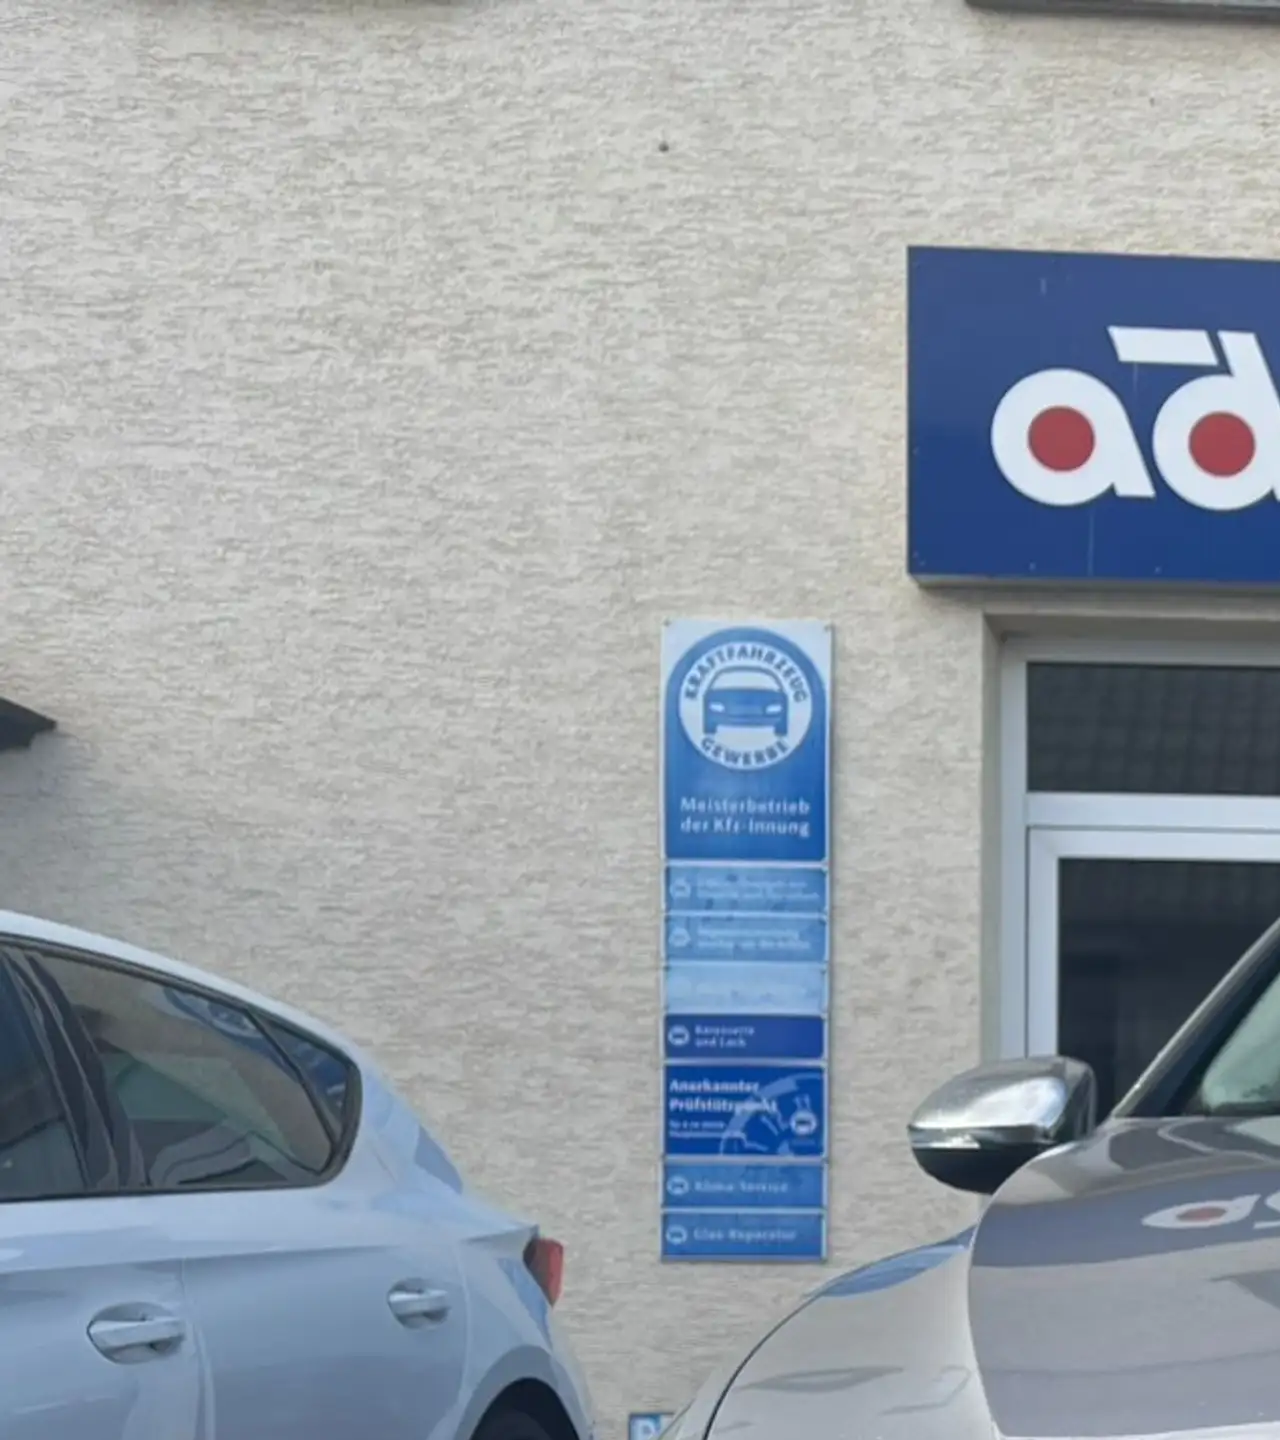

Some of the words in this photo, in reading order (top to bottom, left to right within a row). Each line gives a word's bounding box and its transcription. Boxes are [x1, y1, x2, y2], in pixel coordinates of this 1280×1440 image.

[684, 644, 809, 703] KRAFTFAHRZEUG
[701, 736, 790, 767] GEWERBE
[680, 796, 810, 816] Meisterbetrieb
[680, 815, 708, 834] der
